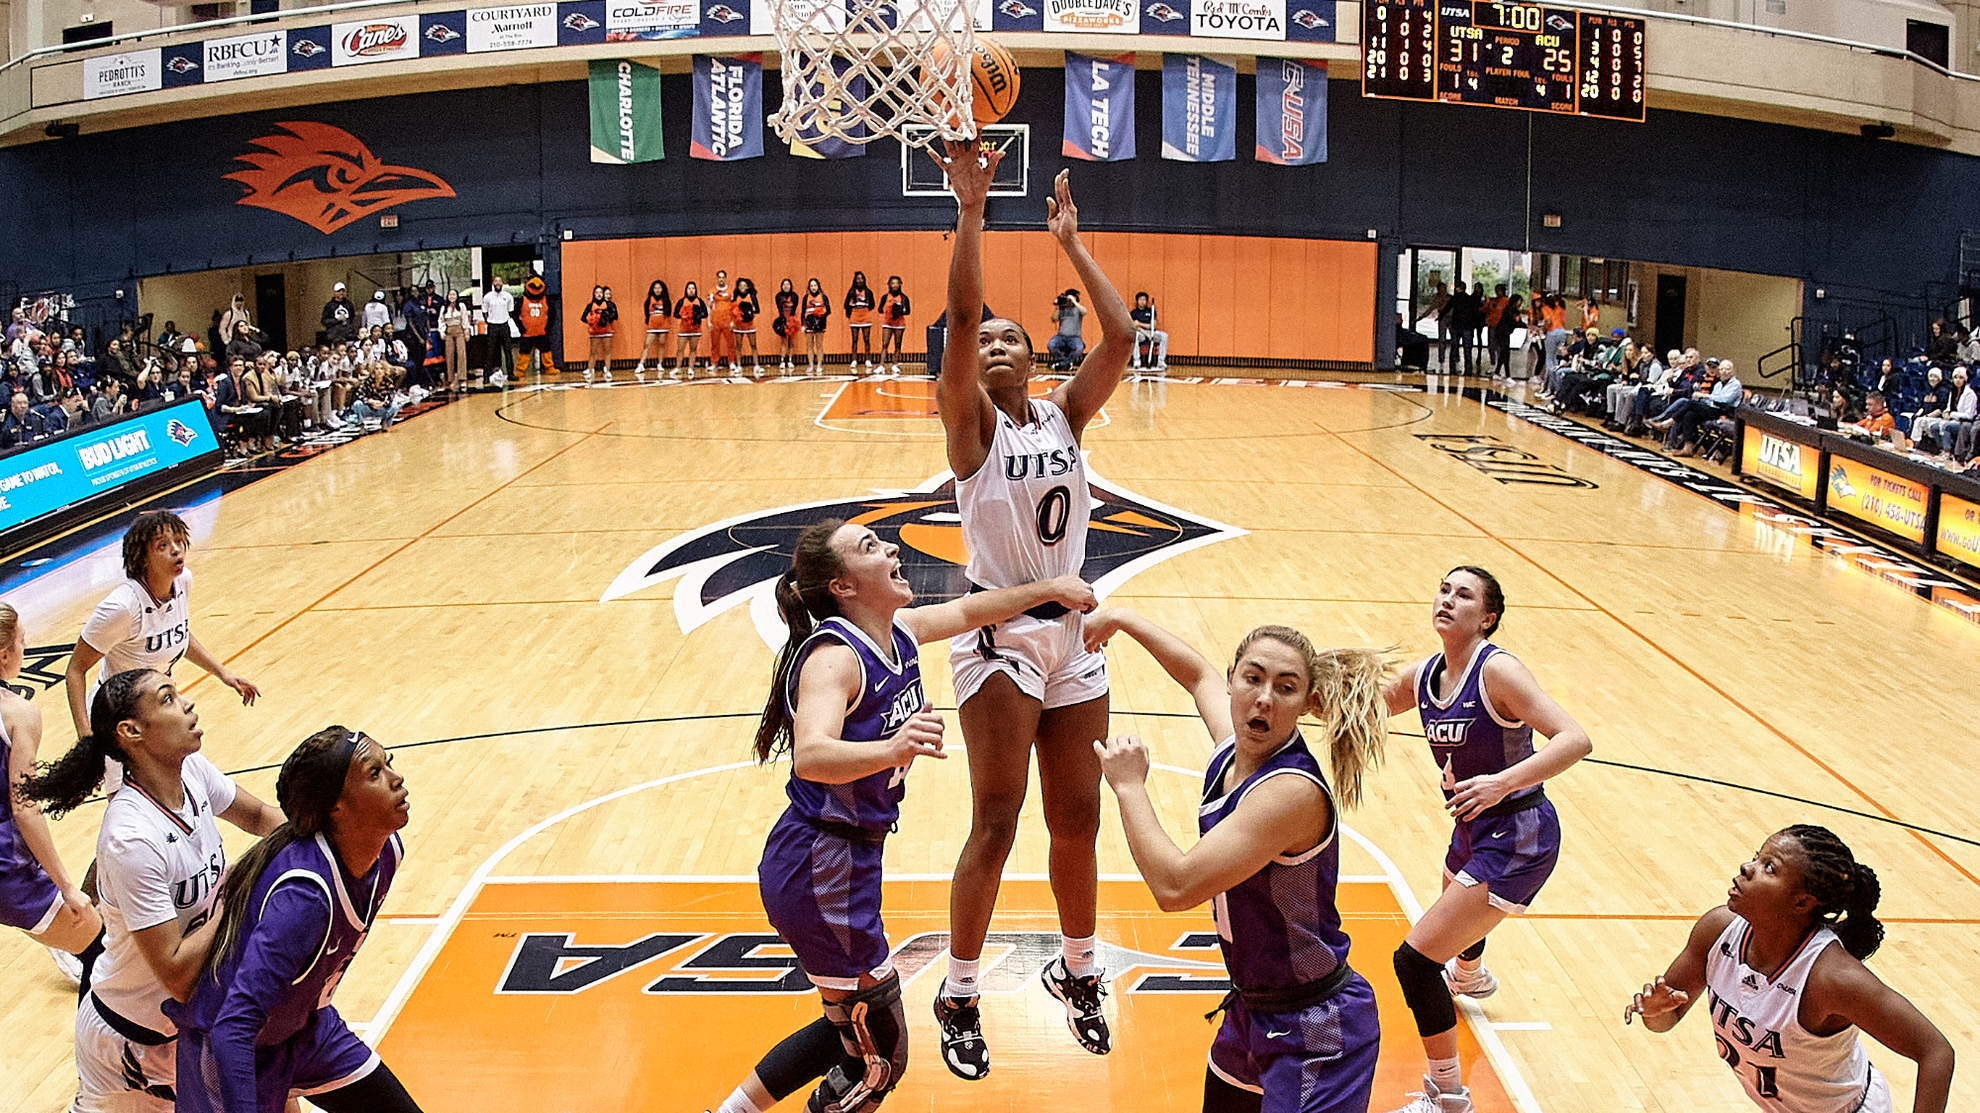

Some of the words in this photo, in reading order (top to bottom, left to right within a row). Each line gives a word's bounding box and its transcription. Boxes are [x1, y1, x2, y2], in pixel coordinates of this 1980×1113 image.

[471, 6, 552, 22] COURTYARD
[612, 5, 692, 18] COLDFIRE
[1377, 6, 1387, 20] 0
[1404, 9, 1410, 20] 1
[1423, 10, 1432, 22] 4
[1441, 7, 1470, 18] UTSA
[1492, 4, 1540, 30] 7:00
[491, 21, 532, 33] Marriott
[1195, 14, 1280, 31] TOYOTA
[1400, 22, 1409, 36] 0
[1423, 24, 1432, 38] 2
[344, 23, 405, 57] Cane's
[1450, 26, 1483, 40] UTSA
[1535, 34, 1560, 47] ACU
[1612, 29, 1621, 42] 0
[1633, 31, 1642, 45] 0
[208, 40, 267, 62] RBFCU
[1371, 36, 1387, 49] 11
[1404, 38, 1410, 49] 1
[1423, 40, 1432, 51] 4
[1450, 39, 1478, 62] 31
[1591, 41, 1600, 55] 3
[1633, 46, 1642, 59] 5
[1367, 49, 1386, 65] 20
[1400, 51, 1409, 65] 0
[1501, 46, 1513, 65] 2
[1543, 48, 1571, 72] 25
[1590, 56, 1600, 69] 4
[99, 64, 145, 83] PEDROTTI'S
[975, 42, 1007, 95] Wilso
[1091, 61, 1109, 91] LA
[1367, 64, 1386, 79] 21
[1399, 66, 1409, 80] 0
[1423, 68, 1431, 82] 3
[1454, 73, 1459, 88] 1
[1468, 78, 1478, 90] 4
[1585, 70, 1599, 84] 12
[1633, 75, 1642, 88] 2
[1536, 84, 1546, 97] 4
[1566, 84, 1571, 99] 1
[1581, 83, 1599, 99] 20
[1611, 87, 1620, 100] 0
[1633, 89, 1642, 103] 0
[617, 60, 635, 161] CHARLOTTE
[711, 57, 727, 157] ATLANTIC
[728, 64, 744, 149] FLORIDA
[1186, 56, 1200, 156] TENNESSEE
[1202, 73, 1217, 138] MIDDLE
[1091, 98, 1109, 159] TECH
[79, 442, 112, 470] BUD
[112, 430, 151, 460] LIGHT
[1759, 434, 1801, 475] UTSA
[1004, 446, 1077, 481] UTSA
[0, 473, 25, 493] GAME
[1870, 475, 1881, 488] FOR
[1883, 478, 1906, 498] TICKETS
[1907, 485, 1921, 503] CALL
[1035, 484, 1071, 547] 0
[1861, 493, 1884, 518] (210)
[888, 685, 920, 728] ACU
[1427, 722, 1466, 743] ACU
